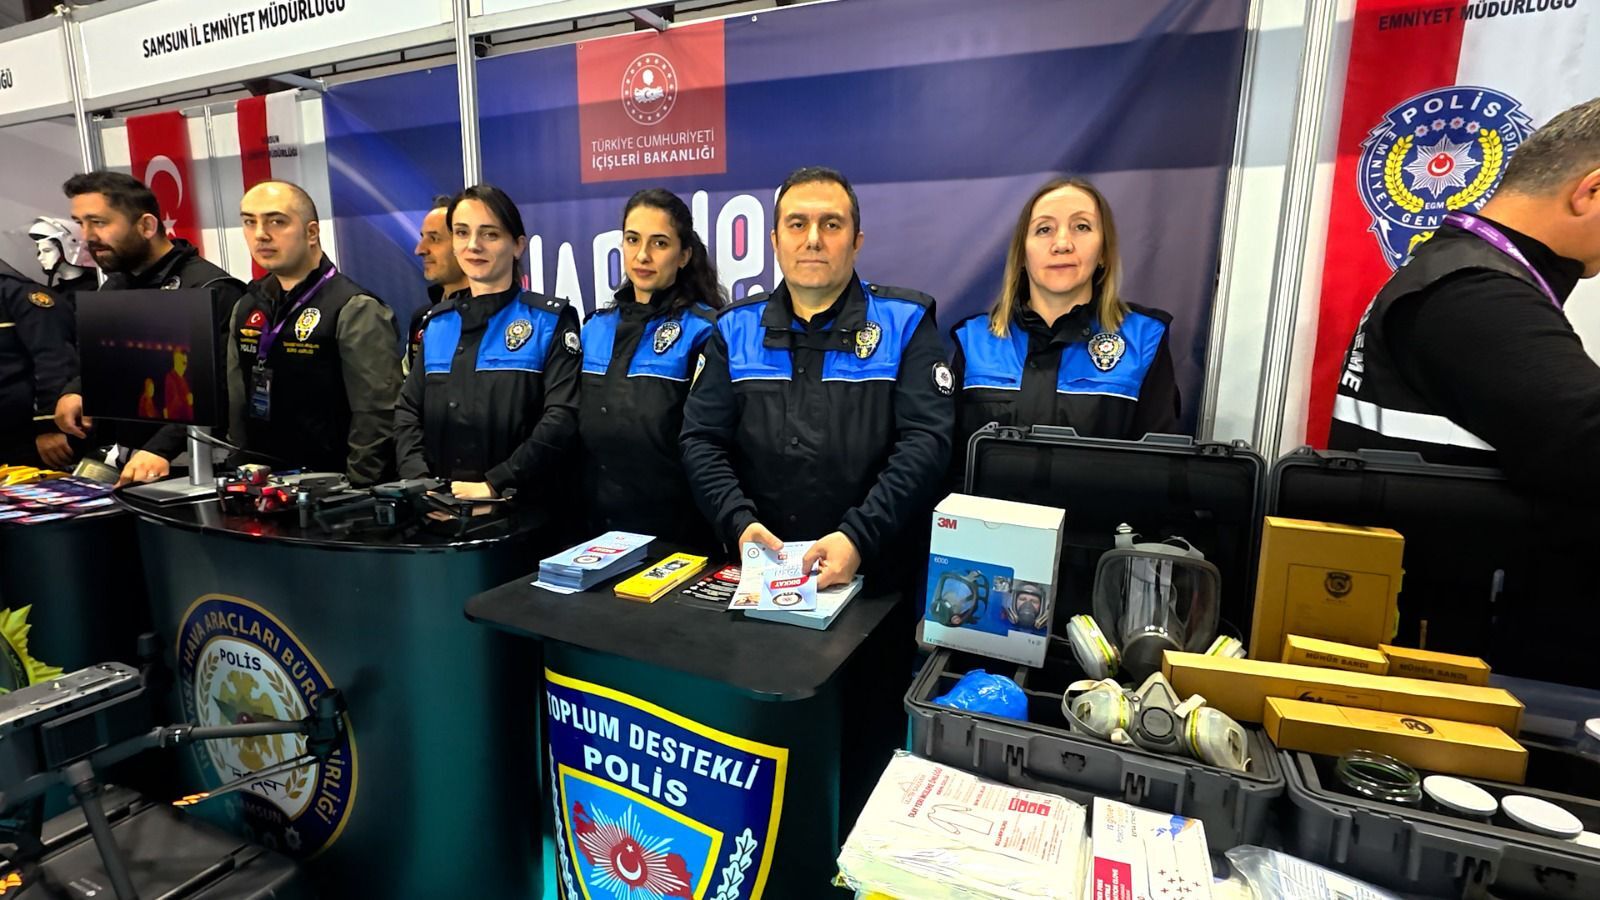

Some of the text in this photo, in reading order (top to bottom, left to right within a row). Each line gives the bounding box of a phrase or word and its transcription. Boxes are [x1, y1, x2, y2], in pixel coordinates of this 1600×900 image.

[1378, 7, 1456, 31] EMNİYET
[143, 29, 189, 58] SAMSUN
[190, 23, 202, 47] İL
[203, 12, 255, 43] EMNİYET
[1402, 92, 1502, 124] POLİS
[592, 127, 715, 152] TÜRKİYE CUMHURİYETİ
[592, 145, 715, 171] İÇİŞLERİ BAKANLIĞI
[1425, 202, 1444, 210] EGM
[1402, 213, 1447, 226] GEN
[937, 517, 957, 530] 3M
[184, 622, 206, 668] HAVA
[204, 611, 280, 653] ARAÇLARI
[220, 648, 262, 671] POLİS
[547, 690, 760, 790] TOPLUM DESTEKLİ
[583, 745, 688, 807] POLİS
